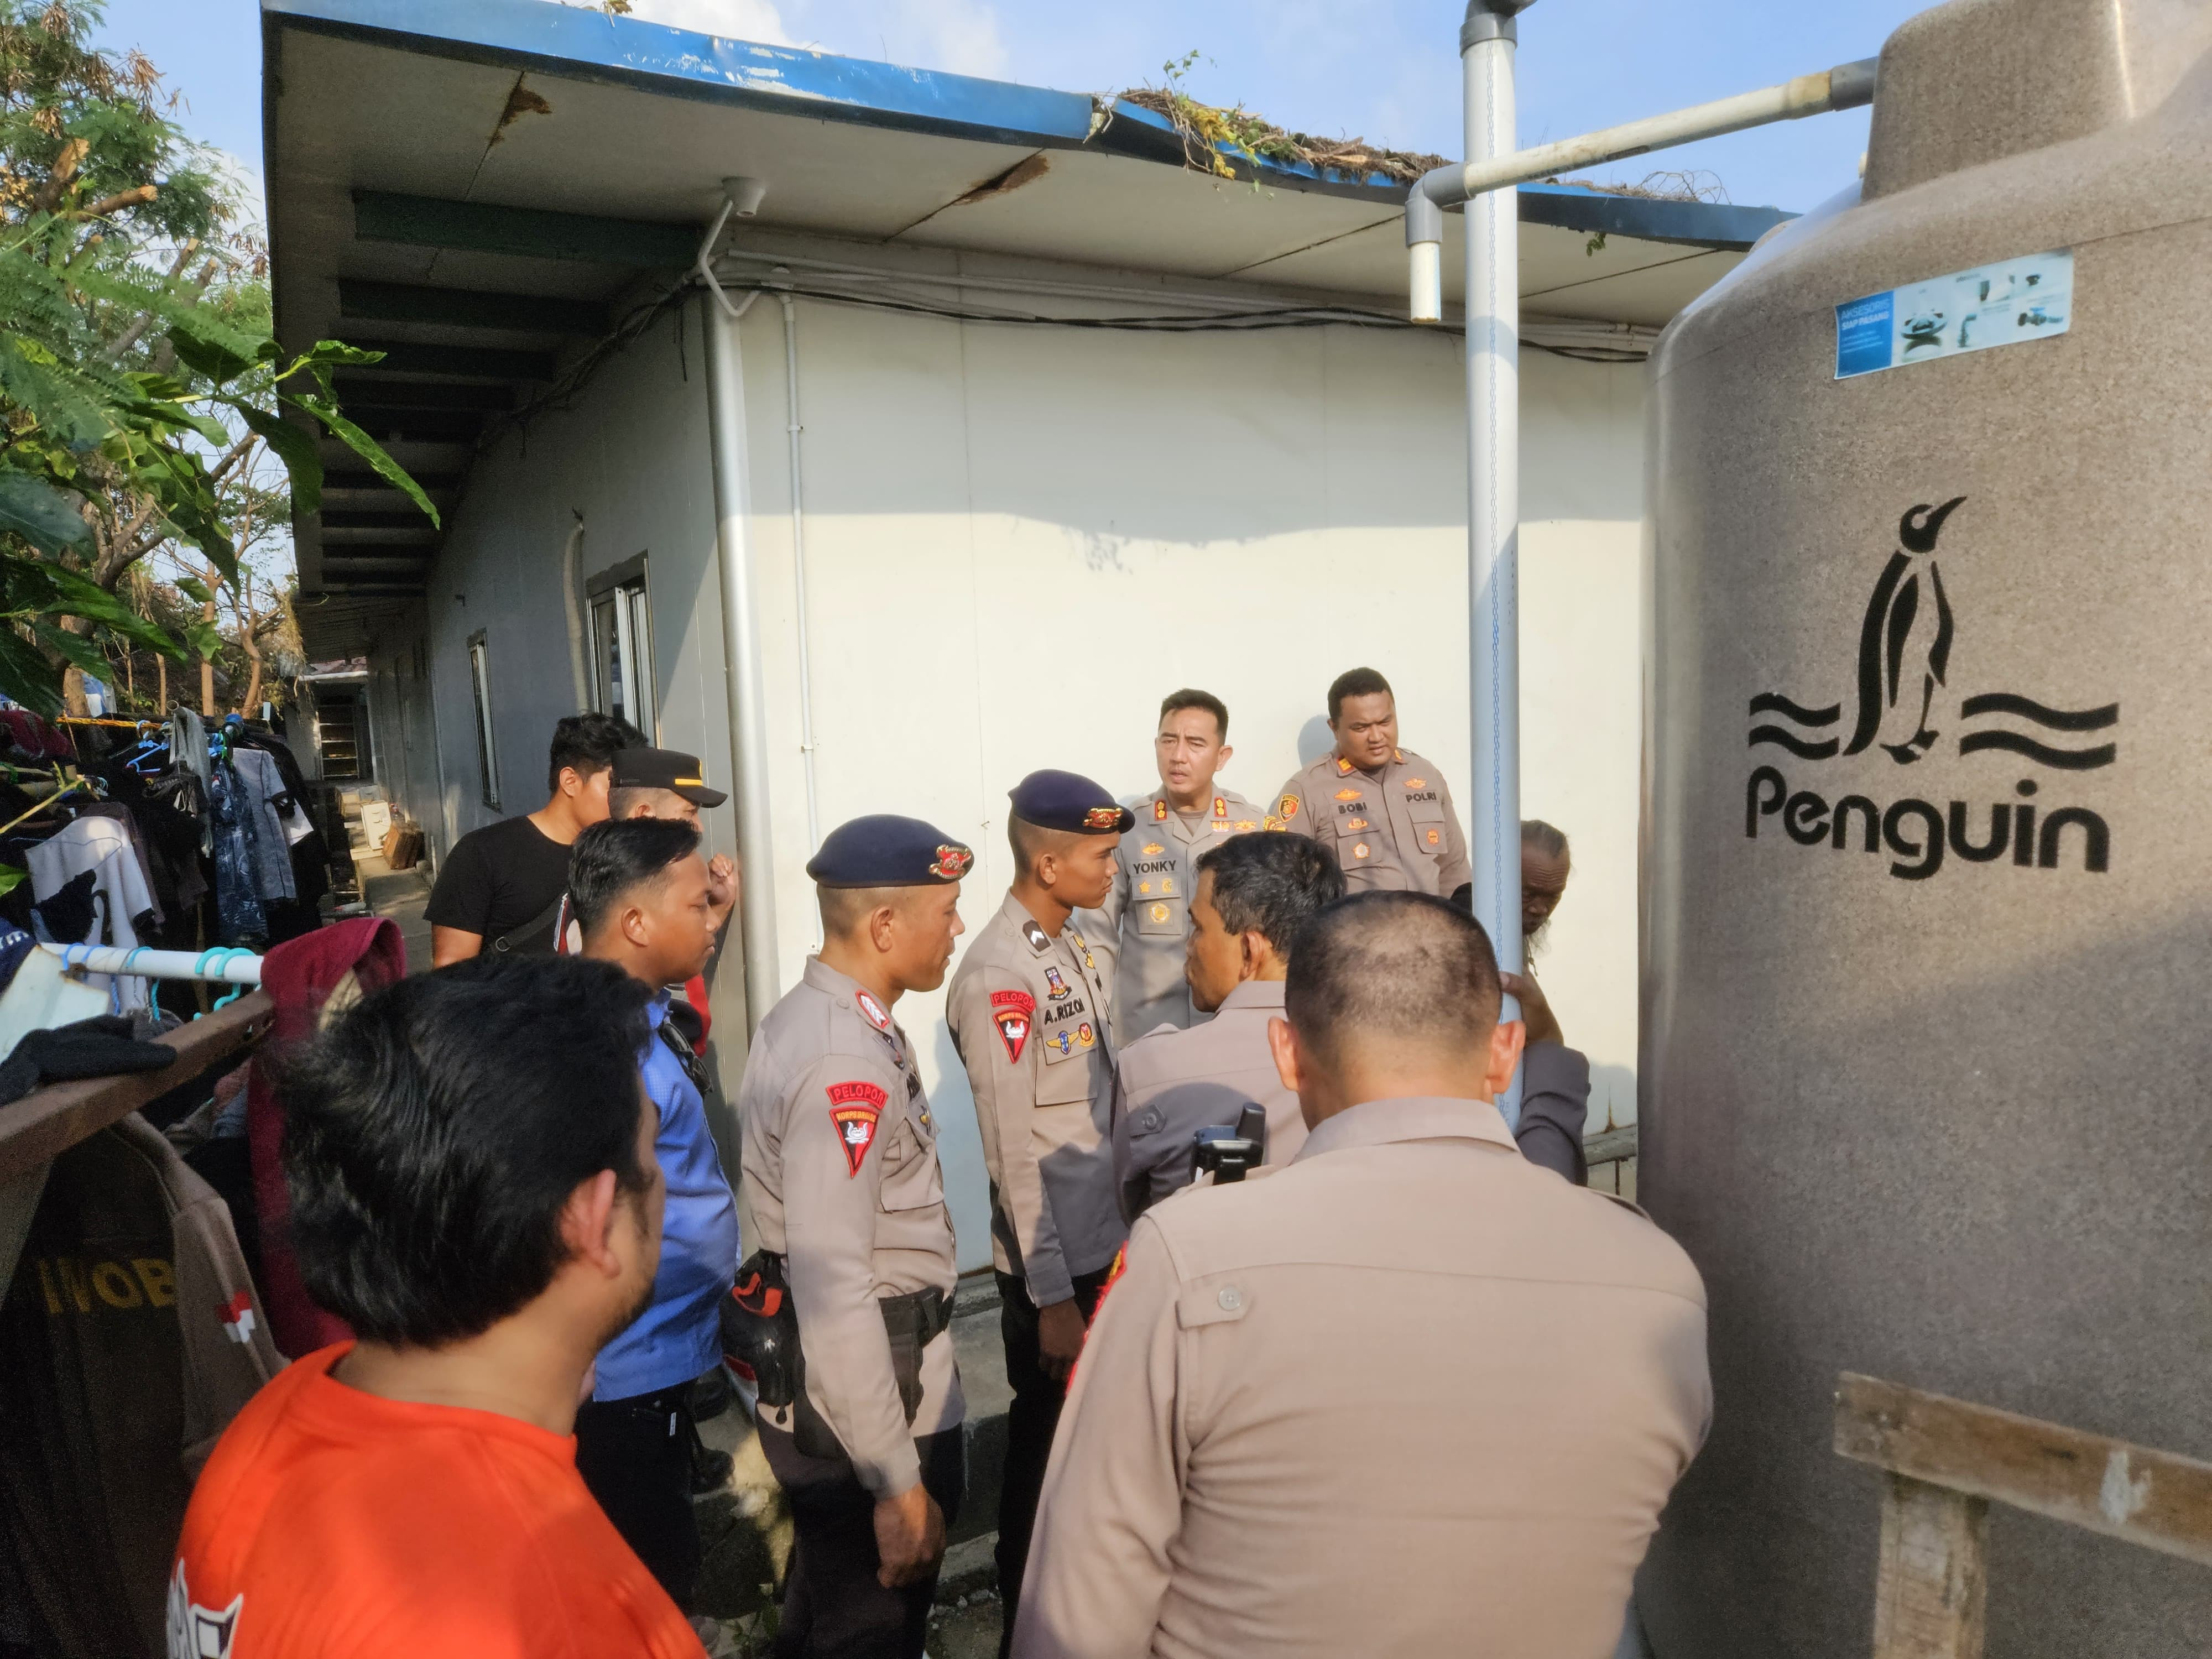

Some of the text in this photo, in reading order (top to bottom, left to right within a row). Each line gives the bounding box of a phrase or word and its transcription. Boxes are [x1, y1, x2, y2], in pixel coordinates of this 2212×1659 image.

[1405, 791, 1437, 803] POLRI
[1338, 801, 1368, 814] BOBI
[1746, 765, 2110, 880] Penguin
[1133, 859, 1177, 874] YONKY
[993, 992, 1034, 1009] PELOPOR
[833, 1084, 884, 1105] PELOPOR
[836, 1110, 857, 1122] KORPS
